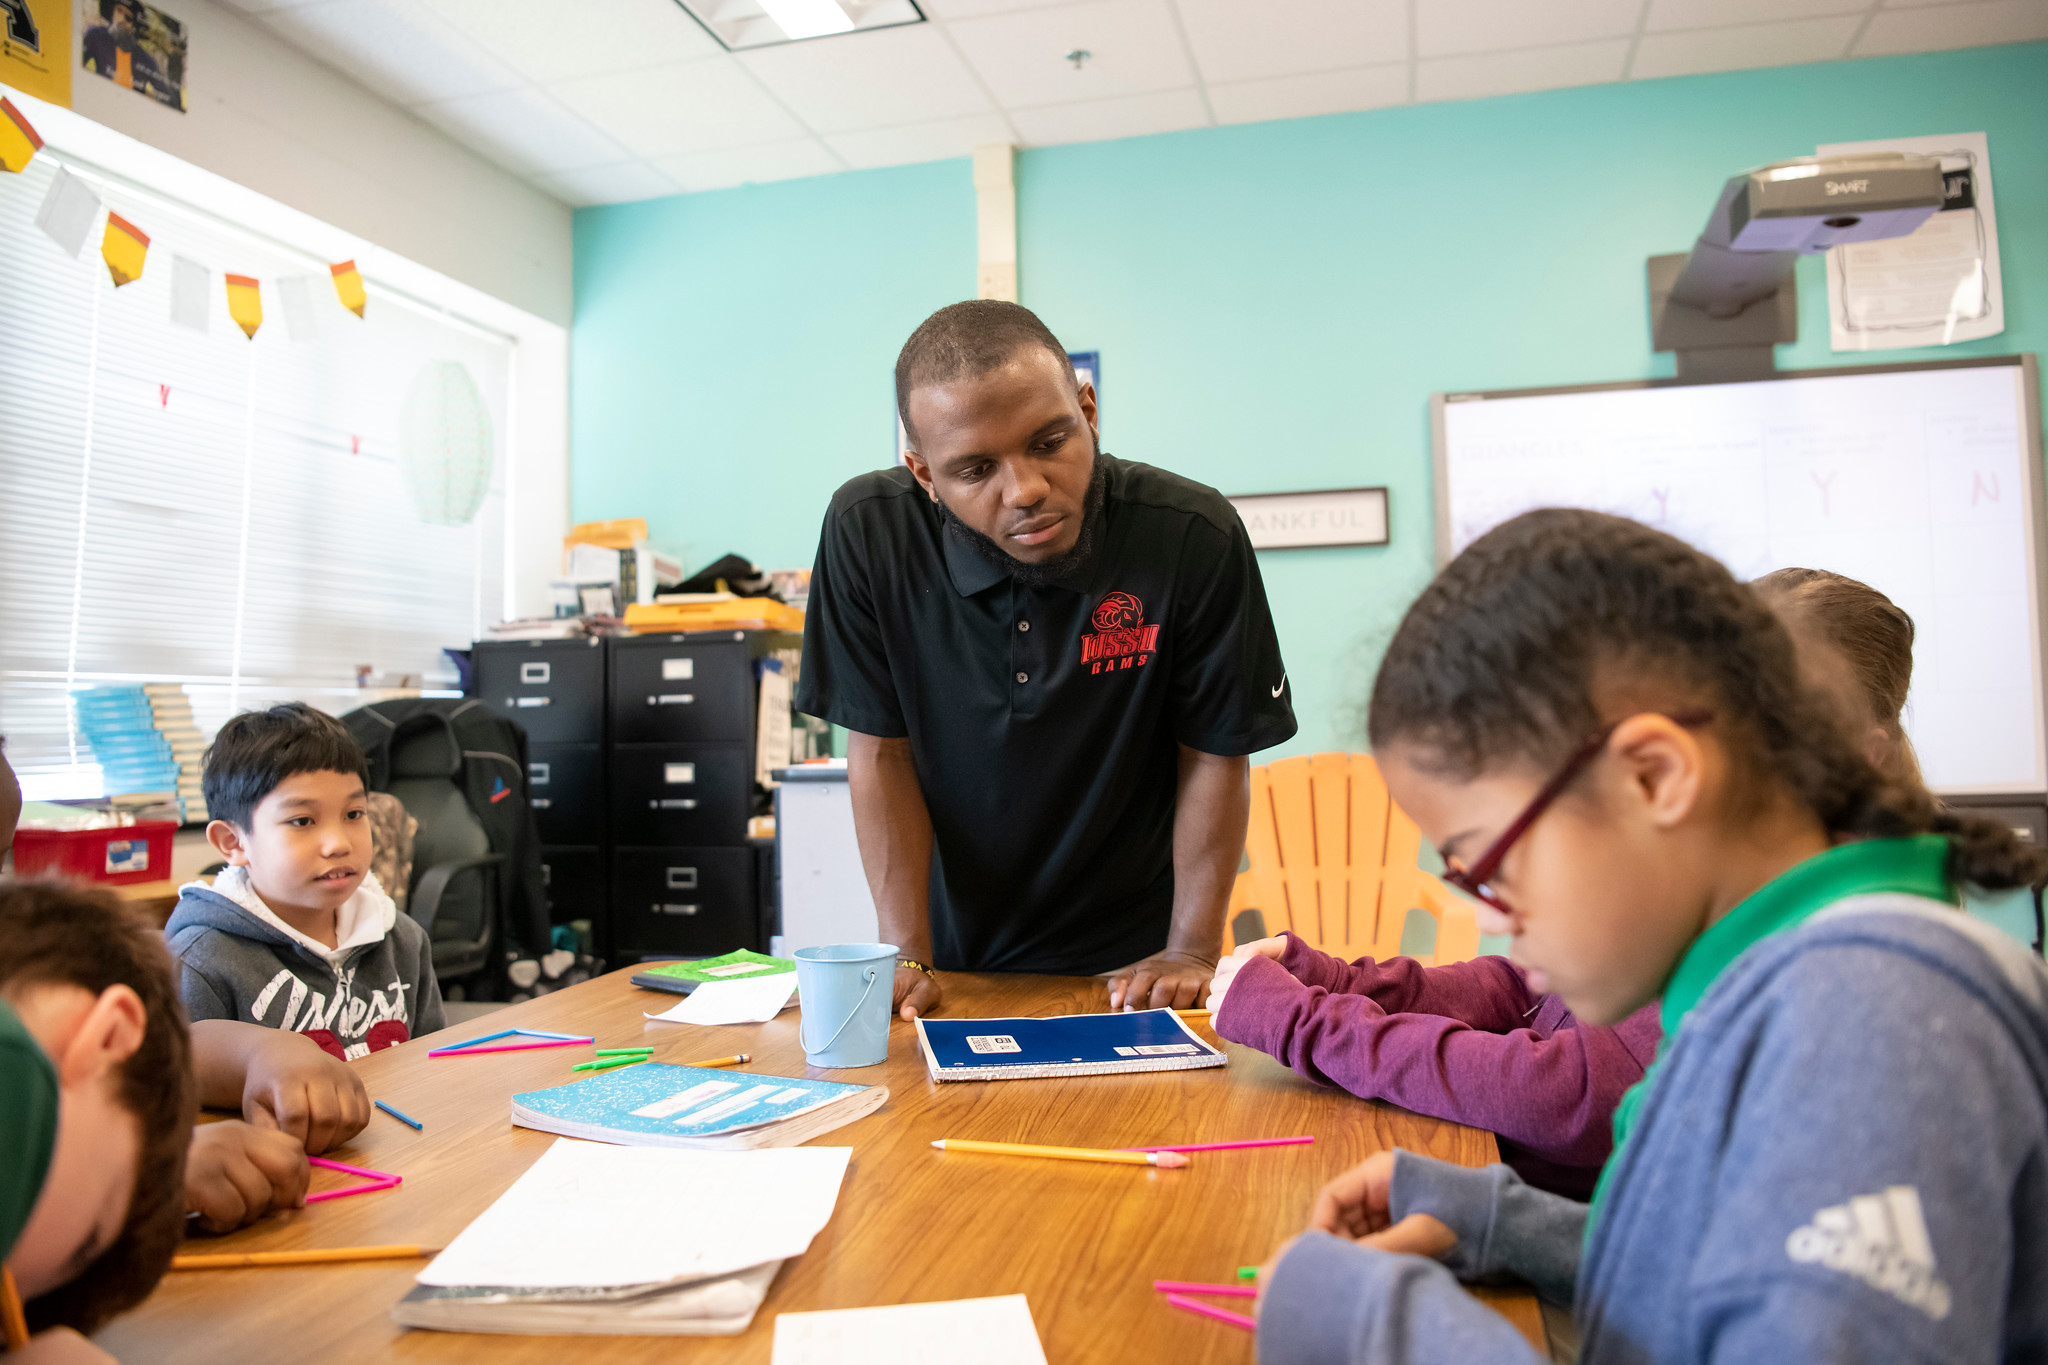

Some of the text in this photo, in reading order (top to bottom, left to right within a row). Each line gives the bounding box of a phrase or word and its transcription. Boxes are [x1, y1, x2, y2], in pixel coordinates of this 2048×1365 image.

[1824, 179, 1869, 196] SMART
[1809, 468, 1838, 516] Y
[1970, 469, 2001, 507] N
[1250, 509, 1364, 532] ANKFUL
[1081, 624, 1160, 665] WSSU
[1091, 654, 1148, 675] RAMS
[251, 968, 411, 1039] West
